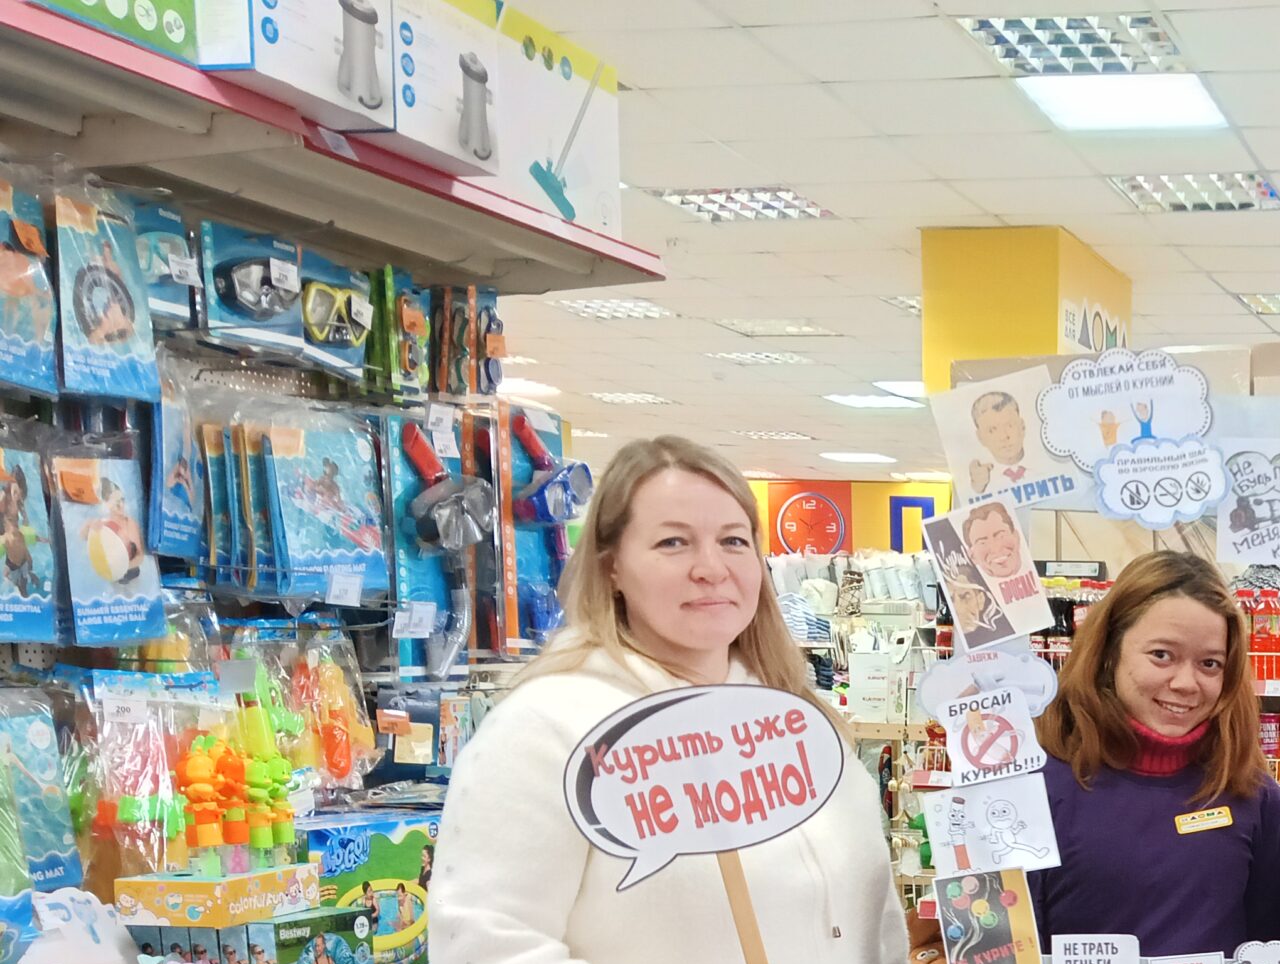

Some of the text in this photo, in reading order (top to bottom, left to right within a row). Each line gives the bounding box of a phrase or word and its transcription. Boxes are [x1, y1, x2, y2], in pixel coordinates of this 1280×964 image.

[1071, 357, 1168, 381] ОТВЛЕКАЙ СЕБЯ
[1068, 374, 1175, 399] ОТ МЫСЛЕЙ О КУРЕНИИ
[1117, 452, 1187, 467] ПРАВИЛЬНЫЙ
[997, 474, 1075, 504] УРИТЬ
[803, 500, 816, 509] 12
[826, 522, 836, 533] 3
[948, 689, 1013, 718] БРОСАЙ
[585, 708, 808, 784] Курить уже
[960, 755, 1042, 784] КУРИТЬ!!!
[45, 866, 64, 880] MAT
[279, 926, 311, 941] Bestway
[1063, 942, 1119, 956] НЕ ТРАТЬ
